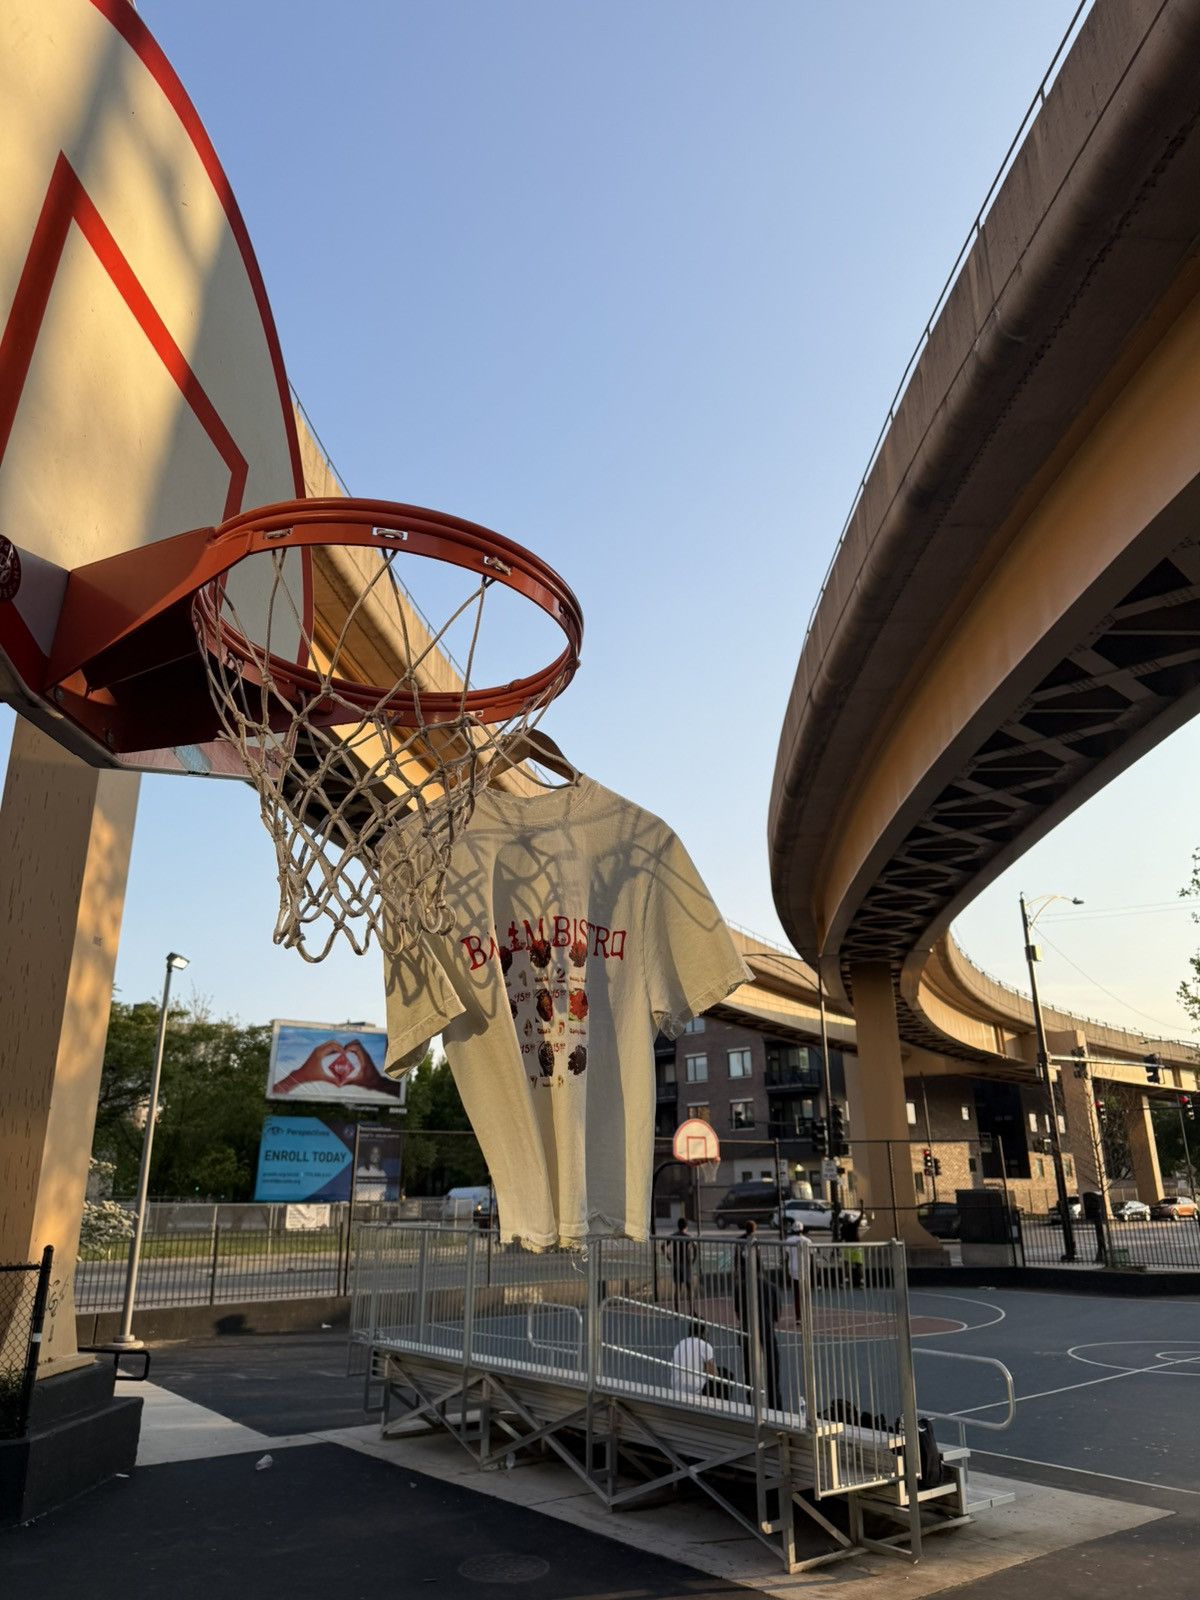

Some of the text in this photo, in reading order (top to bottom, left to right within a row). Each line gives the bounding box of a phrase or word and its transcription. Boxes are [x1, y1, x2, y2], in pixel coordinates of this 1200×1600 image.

[551, 915, 627, 961] BISTRO
[264, 1149, 347, 1164] ENROLL TODAY
